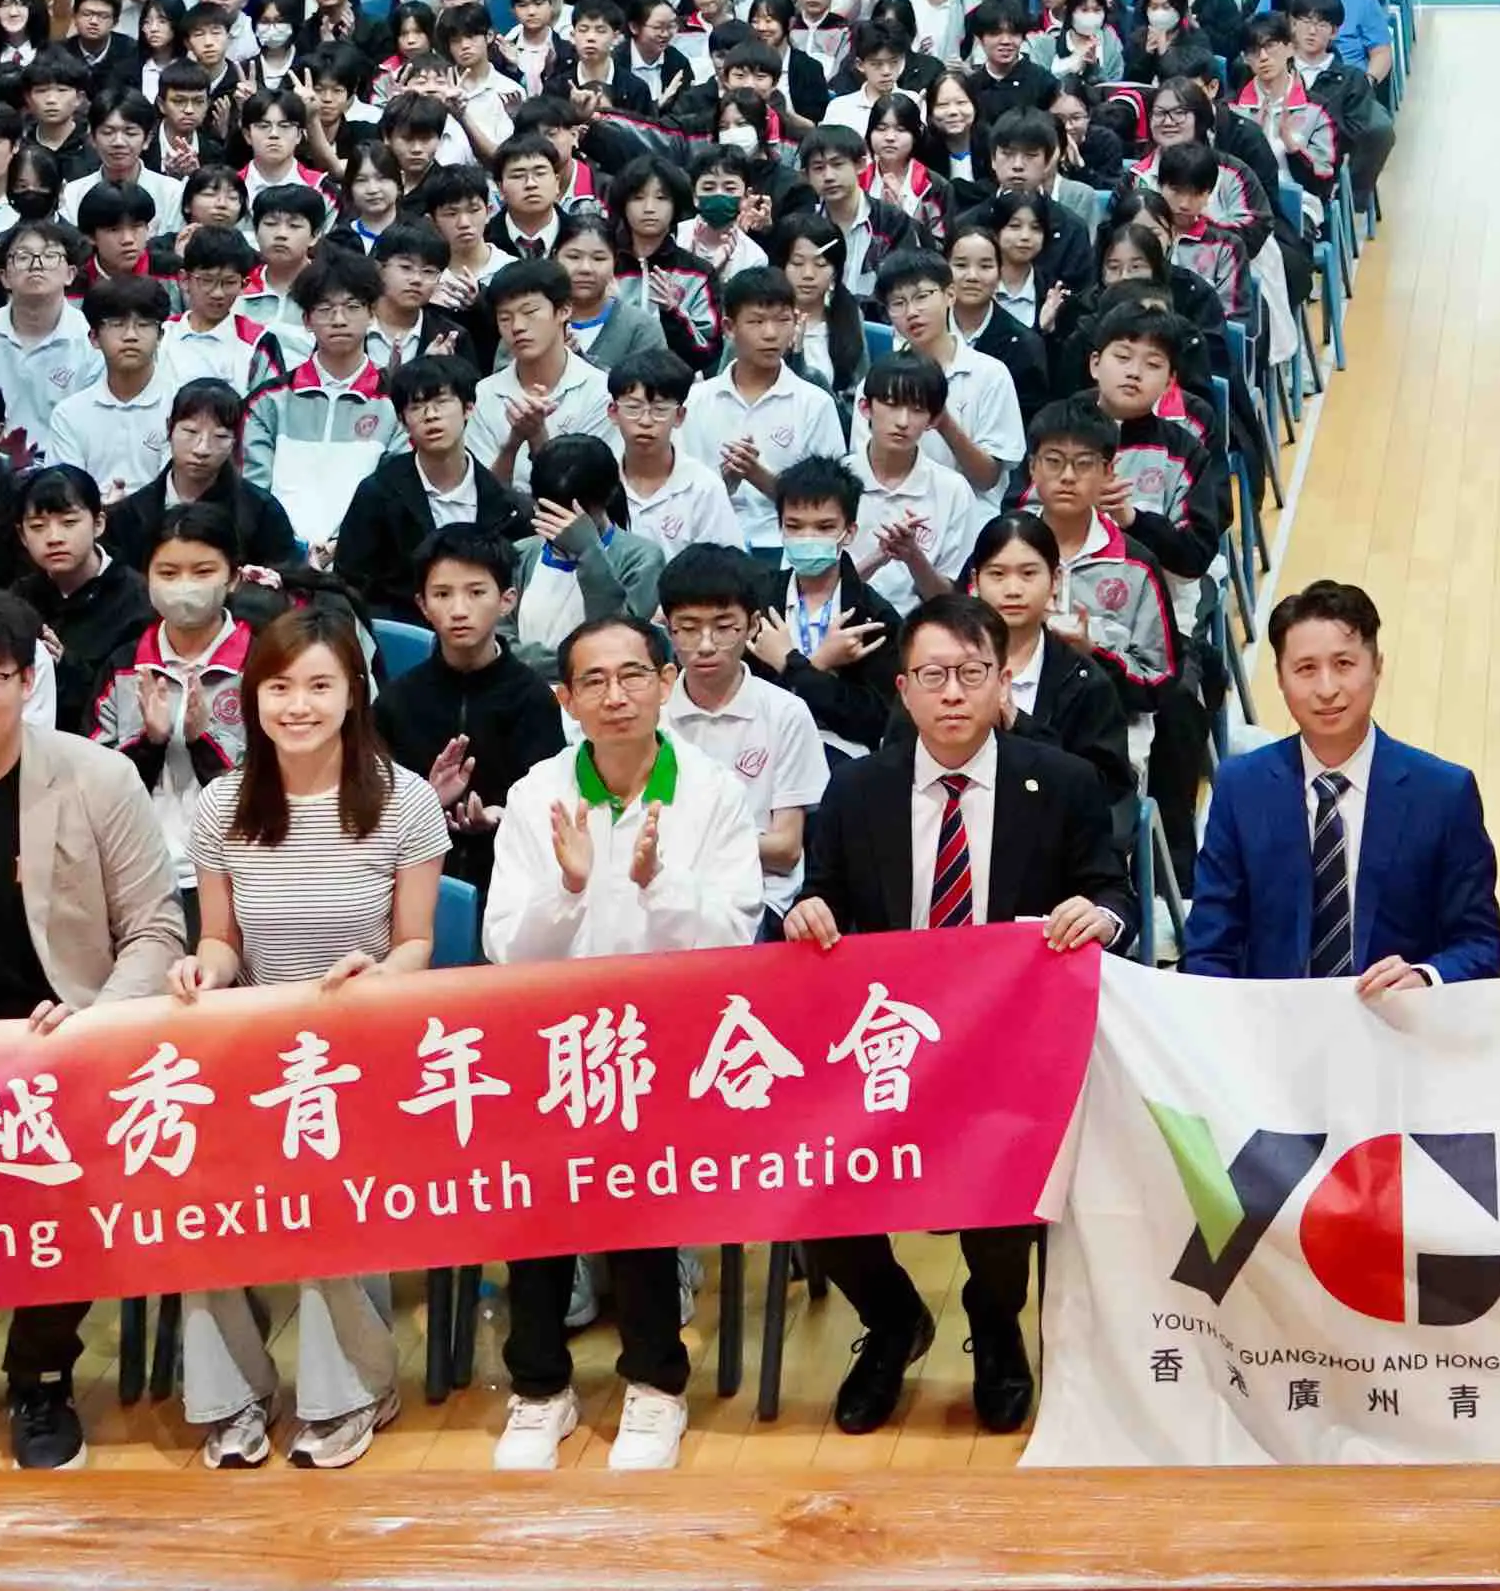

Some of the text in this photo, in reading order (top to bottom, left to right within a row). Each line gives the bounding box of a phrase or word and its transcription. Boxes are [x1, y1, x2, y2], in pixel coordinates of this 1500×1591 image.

[90, 1185, 312, 1250] Yuexiu
[343, 1160, 532, 1223] Youth
[567, 1136, 923, 1203] Federation
[1152, 1312, 1218, 1338] YOUTH
[1239, 1348, 1376, 1374] GUANGZHOU
[1383, 1353, 1429, 1372] AND
[1435, 1353, 1500, 1371] HONG
